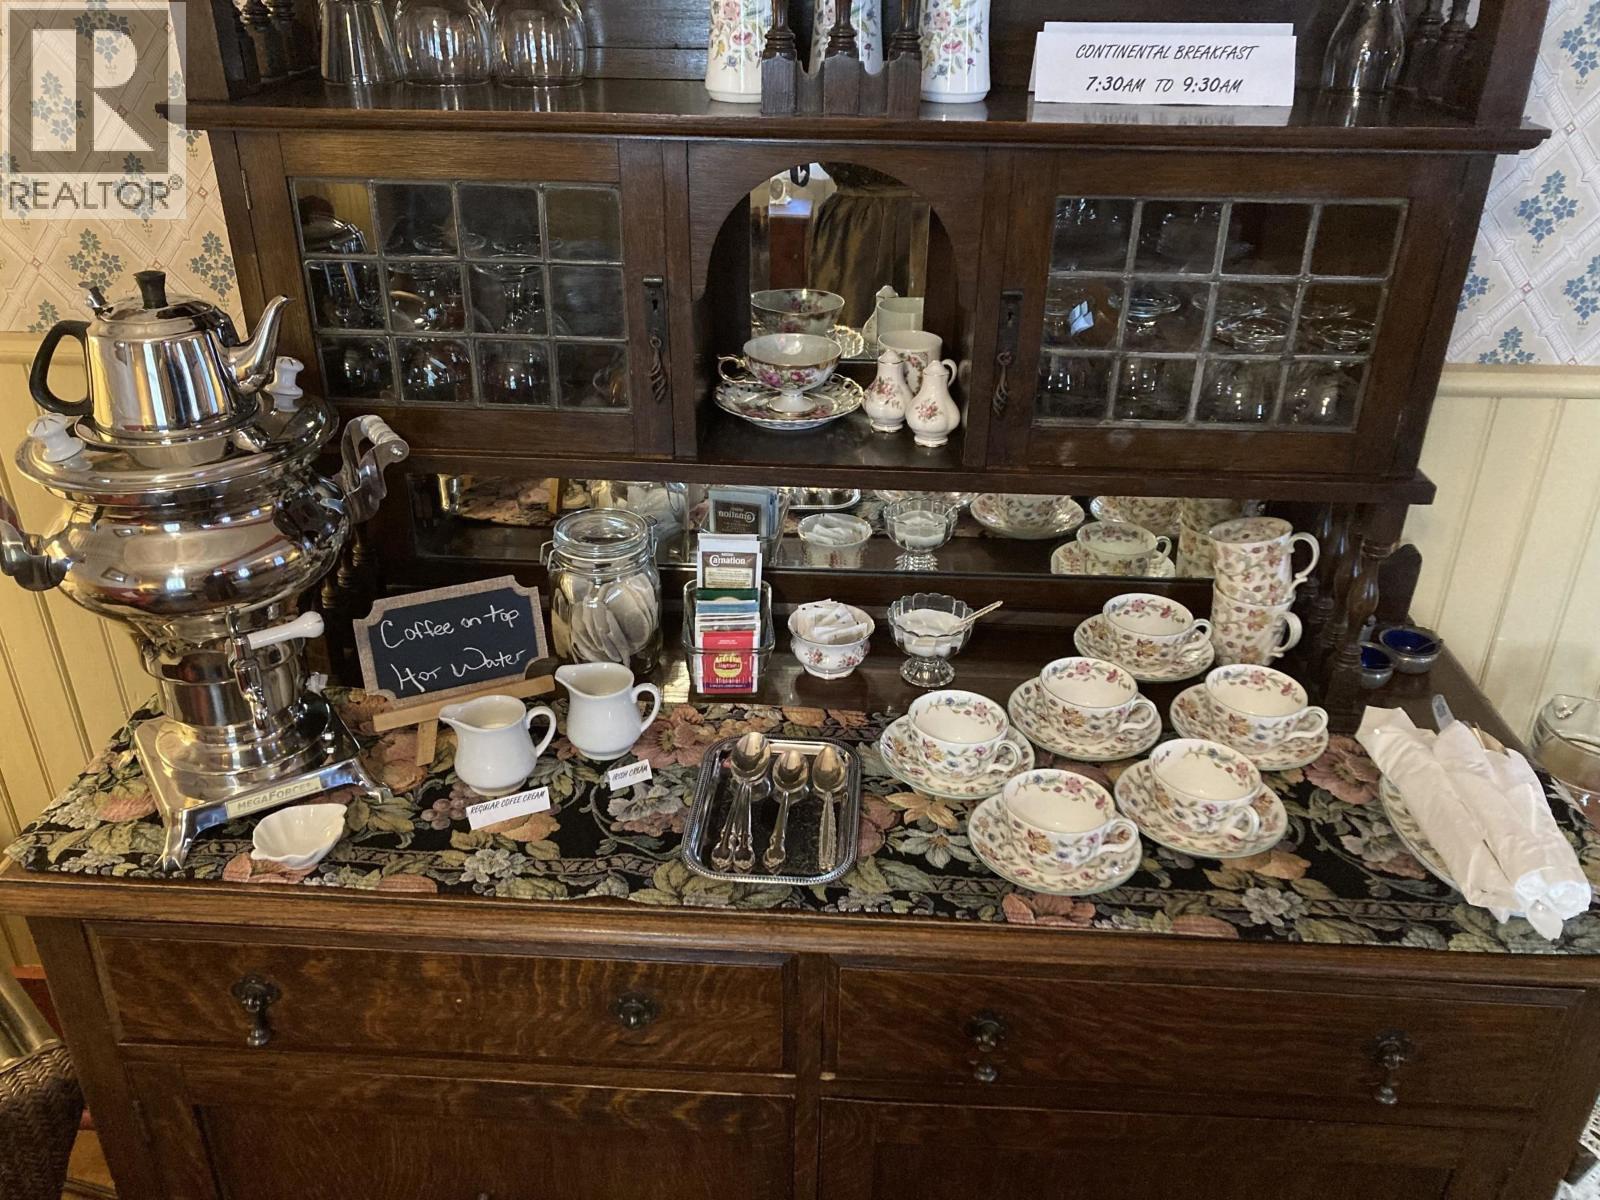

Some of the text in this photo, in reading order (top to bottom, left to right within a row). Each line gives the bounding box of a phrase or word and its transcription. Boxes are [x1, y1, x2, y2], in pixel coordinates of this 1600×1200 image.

[1075, 44, 1259, 60] CONTINENTAL BREAKFAST
[1085, 76, 1244, 93] 7:30AM TO 9:30AM
[380, 604, 520, 649] Coffee on top
[450, 647, 527, 678] Water
[629, 763, 648, 777] CREAM
[470, 800, 500, 814] REGULAR
[522, 790, 546, 802] CREAM
